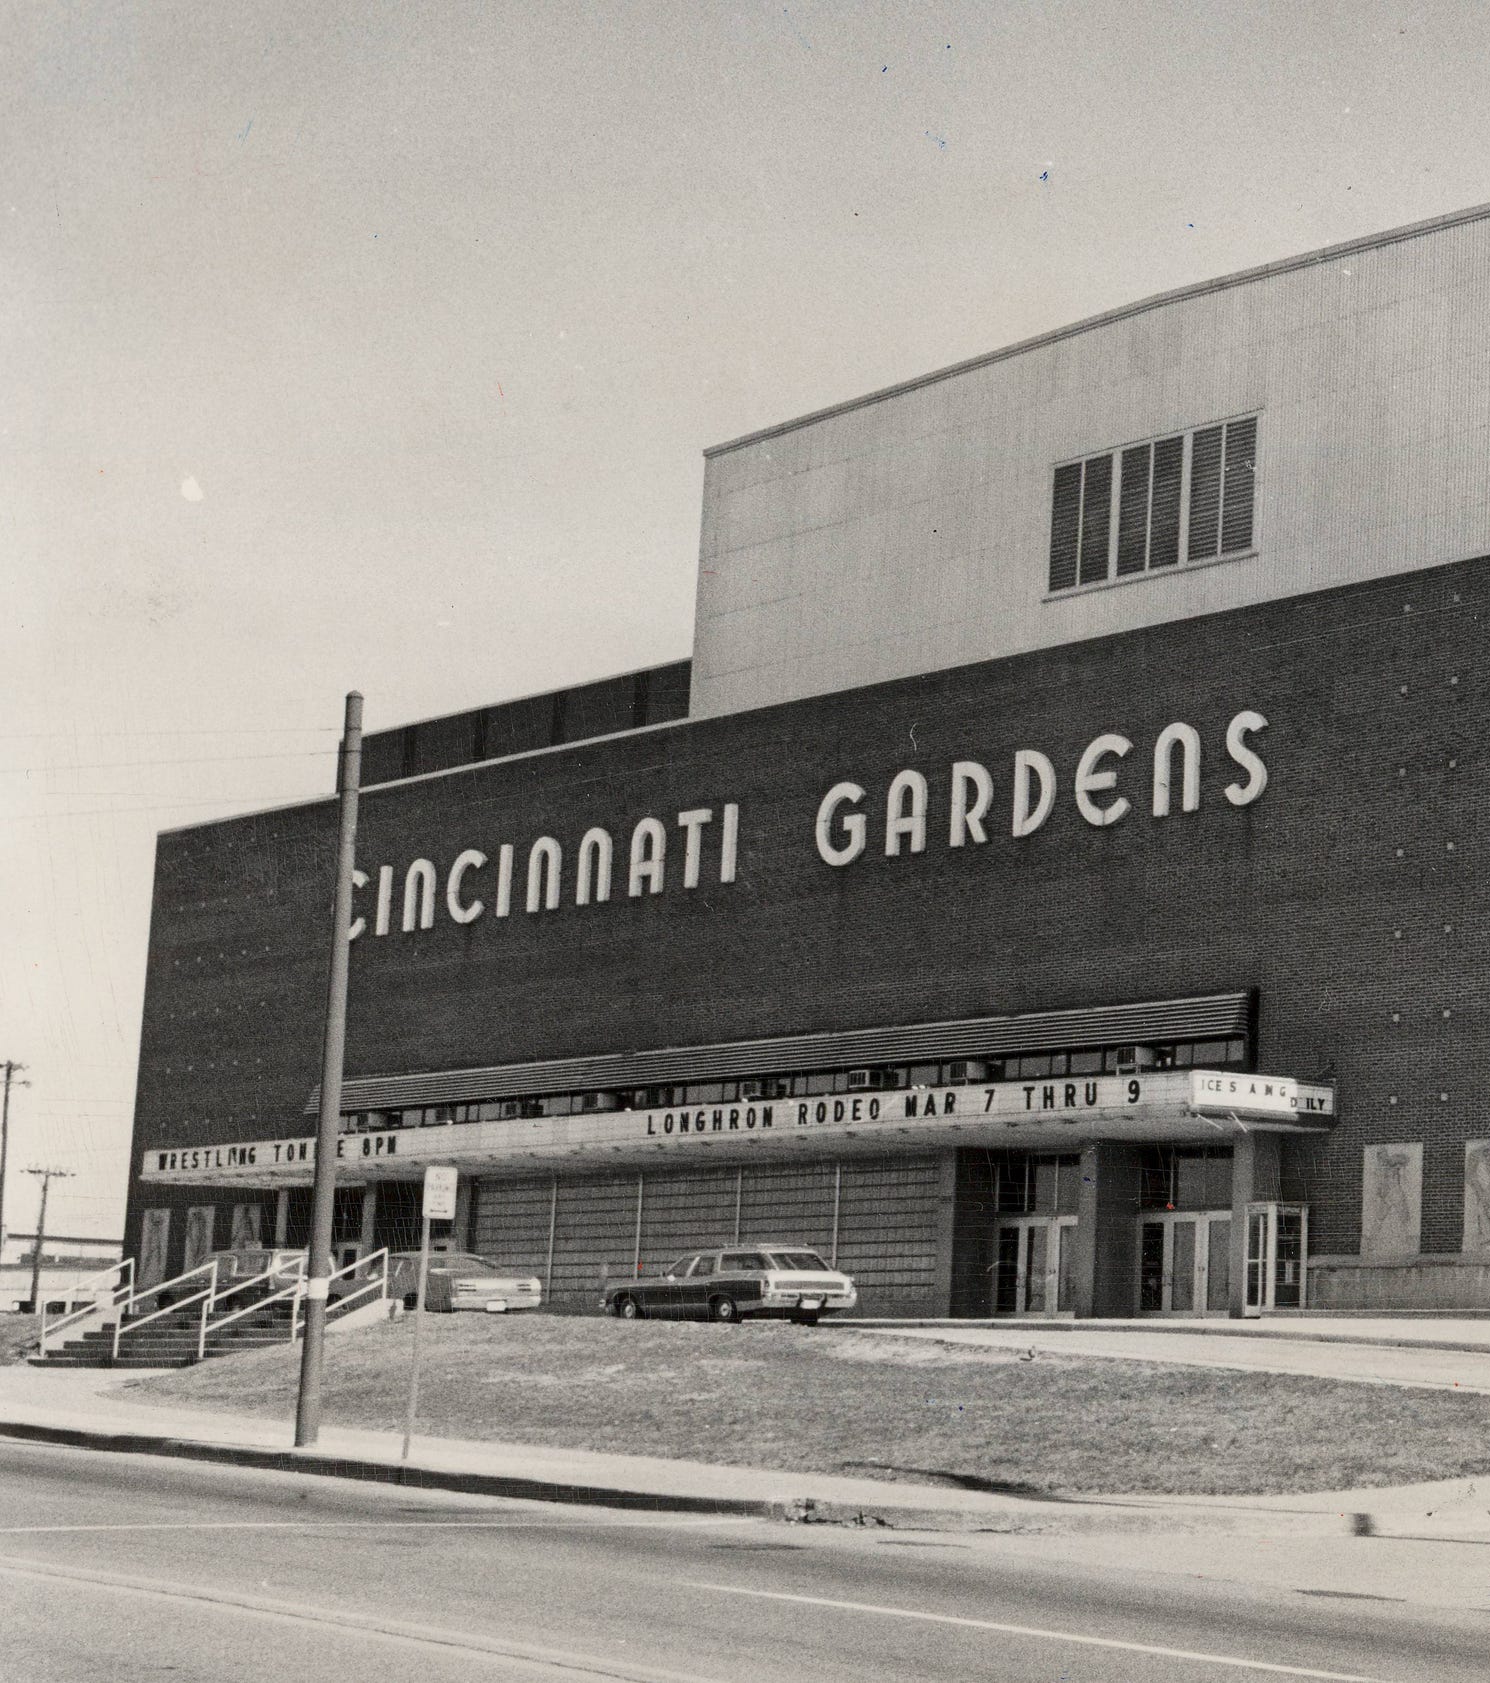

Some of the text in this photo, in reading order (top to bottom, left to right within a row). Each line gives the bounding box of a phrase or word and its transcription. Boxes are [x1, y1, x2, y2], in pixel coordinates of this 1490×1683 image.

[815, 710, 1269, 867] GARDENS
[647, 1079, 1140, 1135] LONGHRON RODEO MAR 7 THRU 9
[1290, 1096, 1326, 1111] DILY
[158, 1135, 397, 1171] WRESTLING TONE 8PM
